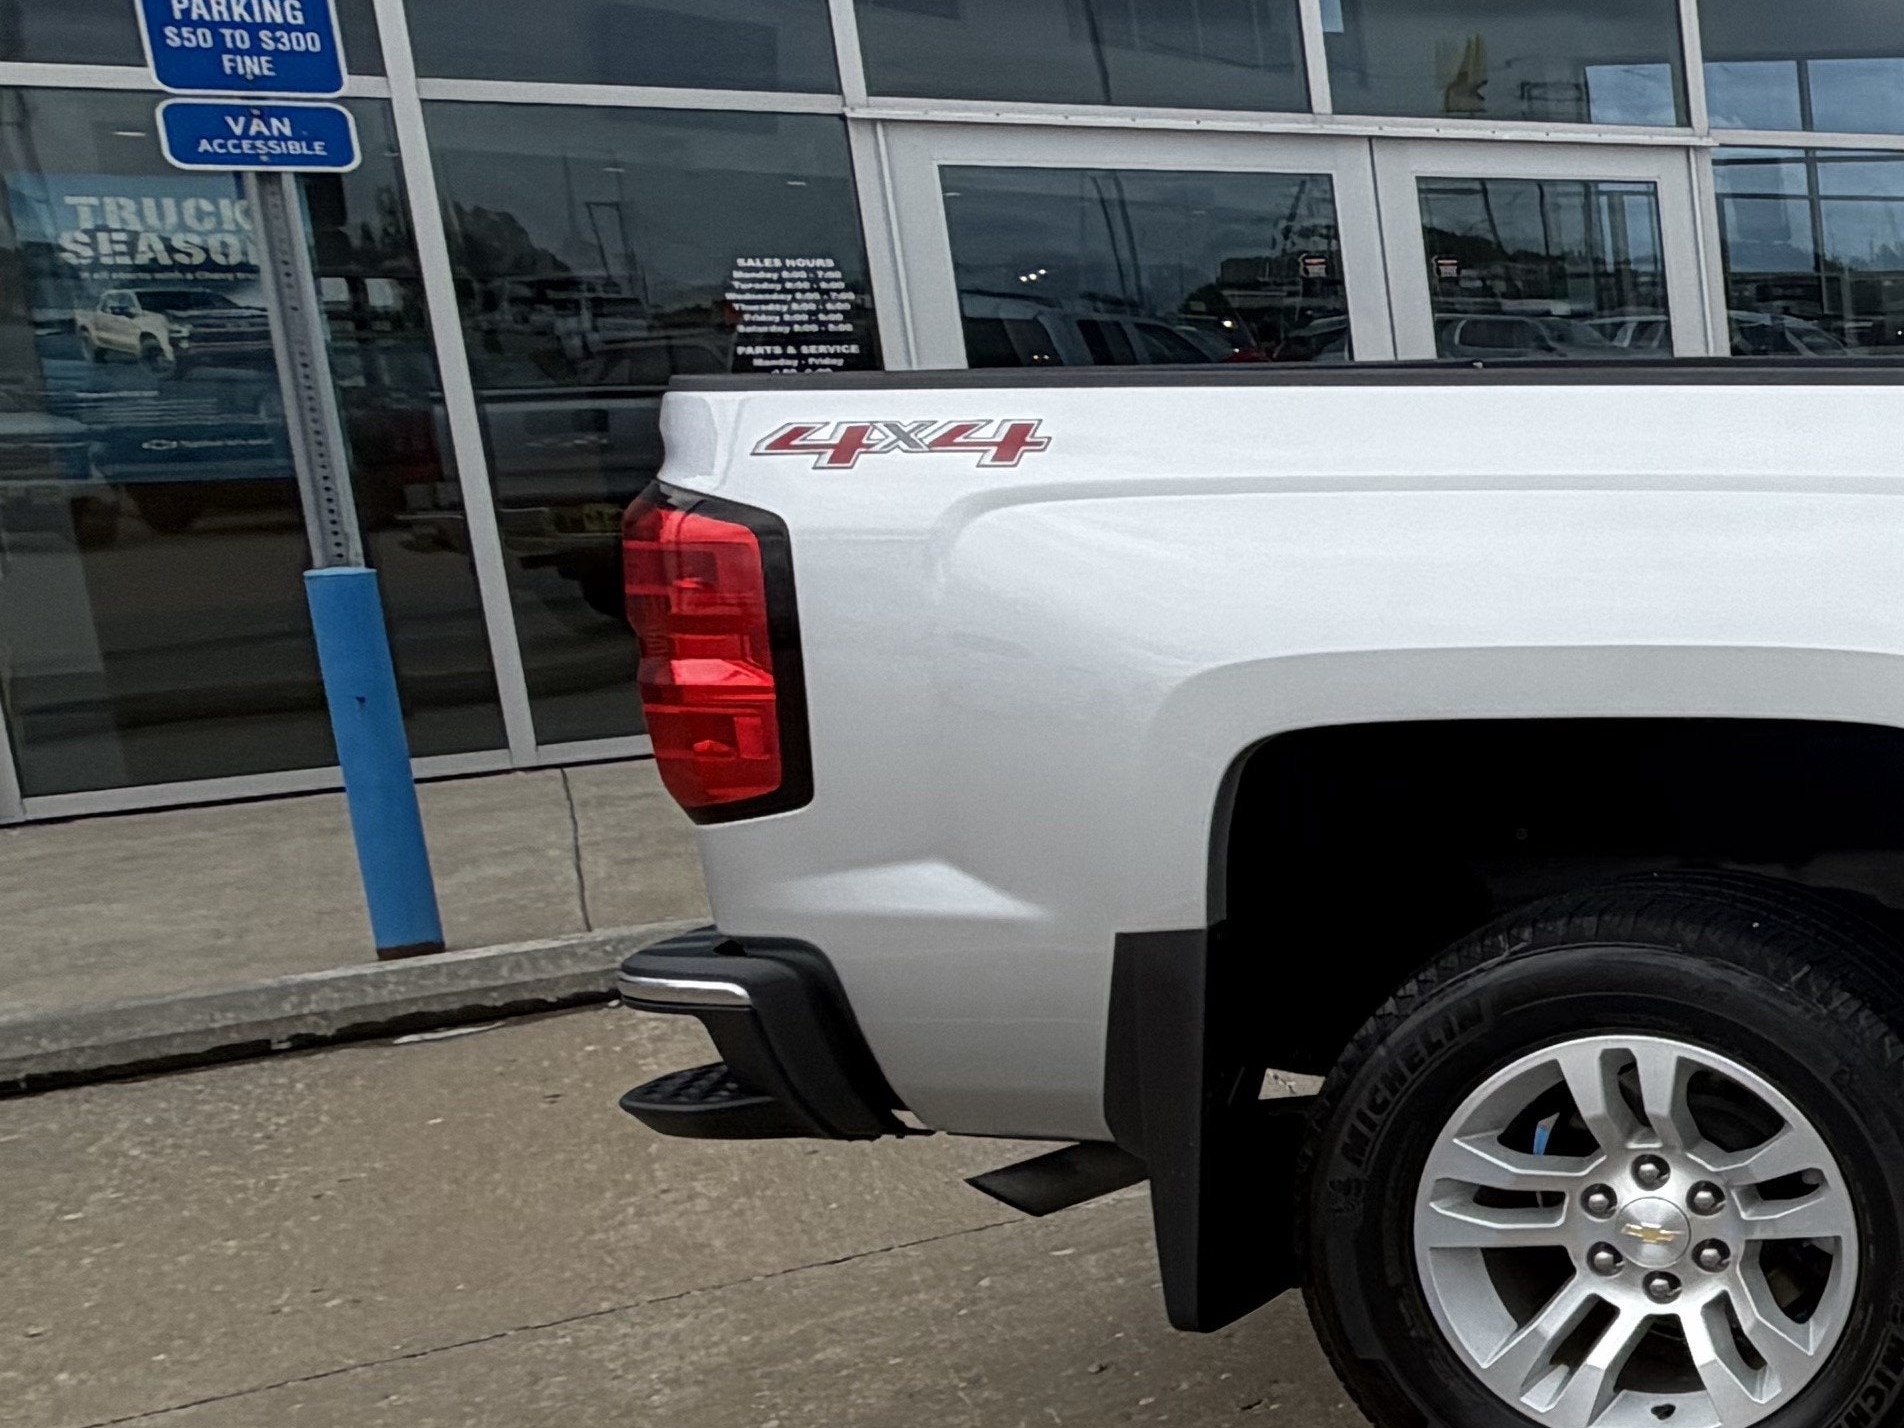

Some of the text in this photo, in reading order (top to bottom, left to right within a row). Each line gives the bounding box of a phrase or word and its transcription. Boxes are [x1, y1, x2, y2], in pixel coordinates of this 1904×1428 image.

[219, 28, 251, 50] TO
[222, 54, 277, 77] FINE
[224, 116, 292, 137] VAN
[197, 138, 328, 156] ACCESSIBLE
[63, 195, 255, 232] TRUCK
[736, 258, 835, 267] SALES HOURS
[732, 270, 779, 280] Monday
[731, 281, 782, 290] Tuesday
[736, 345, 782, 355] PARTS
[801, 344, 860, 354] SERVICE
[1341, 997, 1484, 1168] MICHELIN
